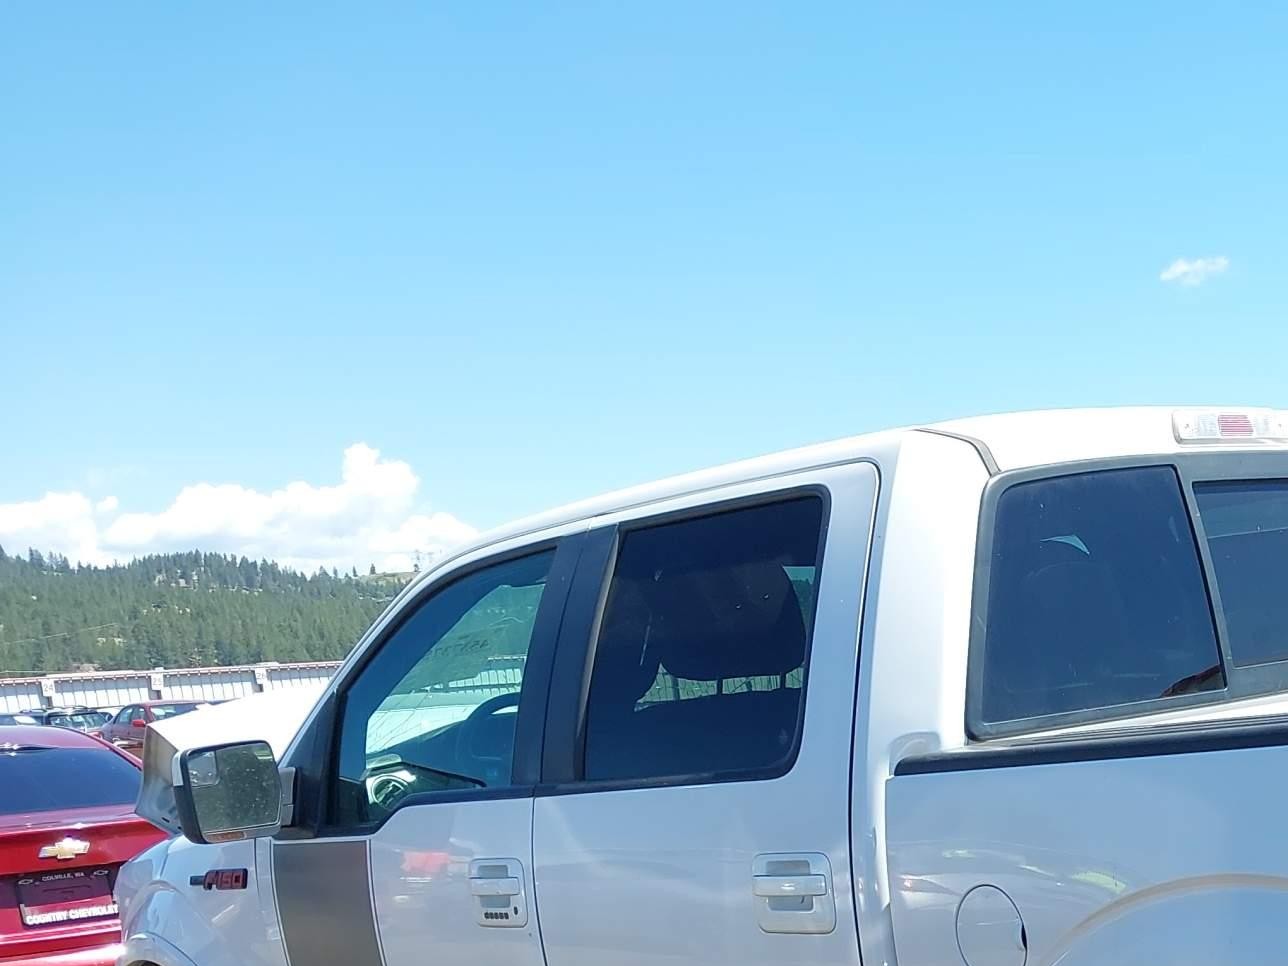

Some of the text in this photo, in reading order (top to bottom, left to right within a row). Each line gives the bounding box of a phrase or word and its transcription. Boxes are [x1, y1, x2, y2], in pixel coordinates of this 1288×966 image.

[43, 683, 54, 692] 24
[26, 904, 119, 925] COUNTRY CHEVROLET
